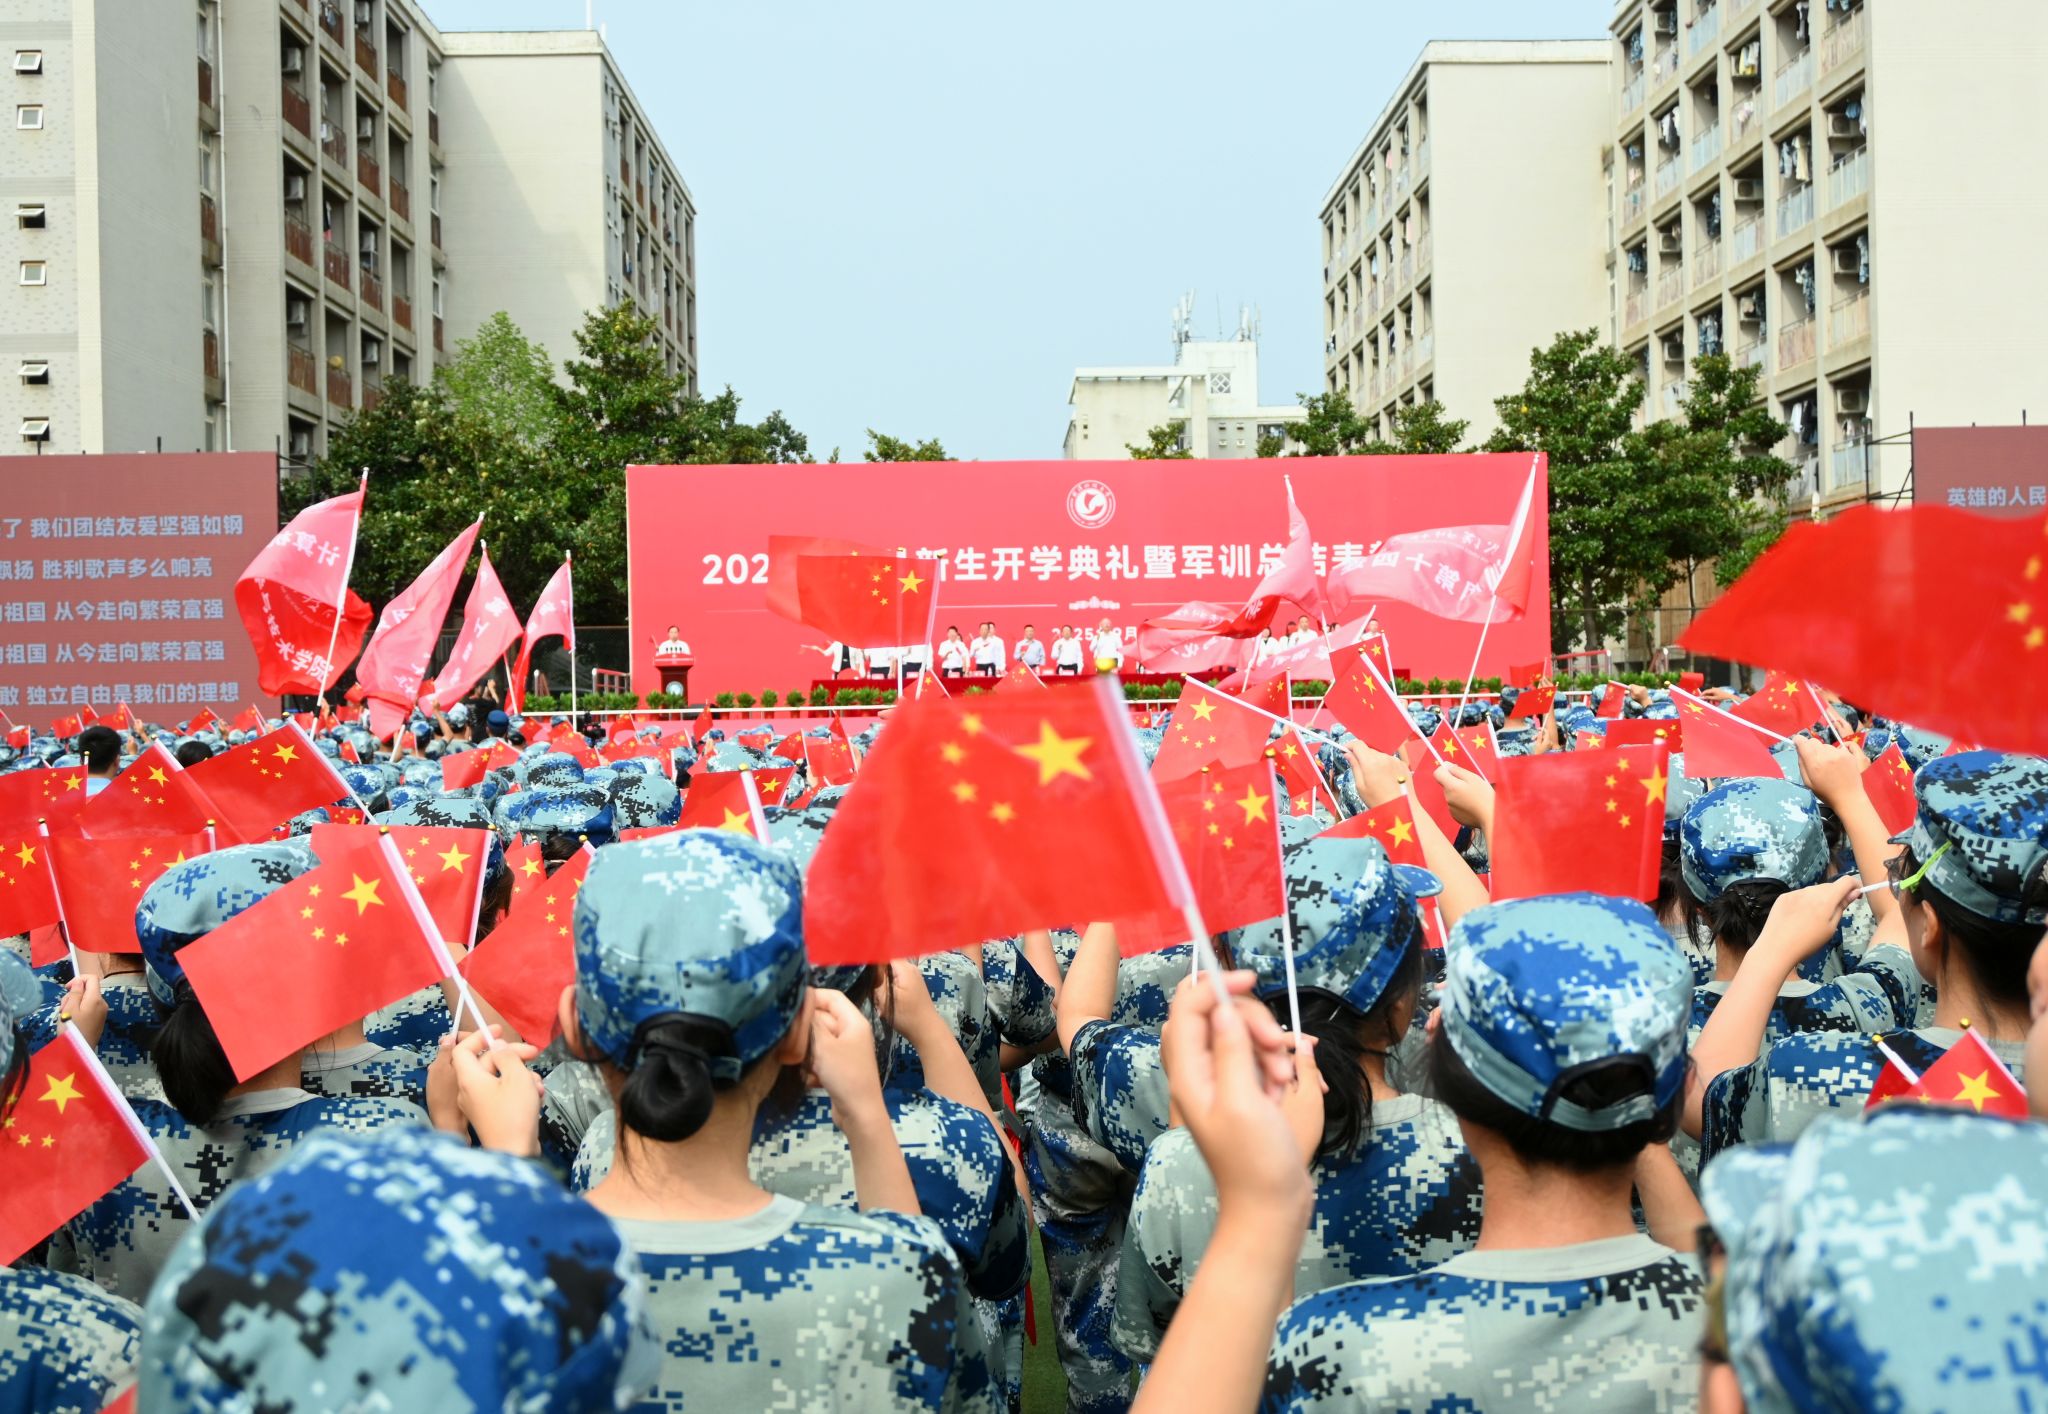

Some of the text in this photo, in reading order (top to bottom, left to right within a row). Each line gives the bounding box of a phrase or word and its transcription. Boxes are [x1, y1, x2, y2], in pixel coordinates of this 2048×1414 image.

[1947, 486, 2046, 508] 英雄的人民
[31, 515, 243, 538] 我们团结友爱坚强如钢
[43, 557, 212, 580] 胜利歌声多么响亮
[0, 599, 224, 622] 祖国 从今走向繁荣富强
[0, 641, 225, 664] 祖国 从今走向繁荣富强
[27, 682, 239, 705] 独立自由是我们的理想
